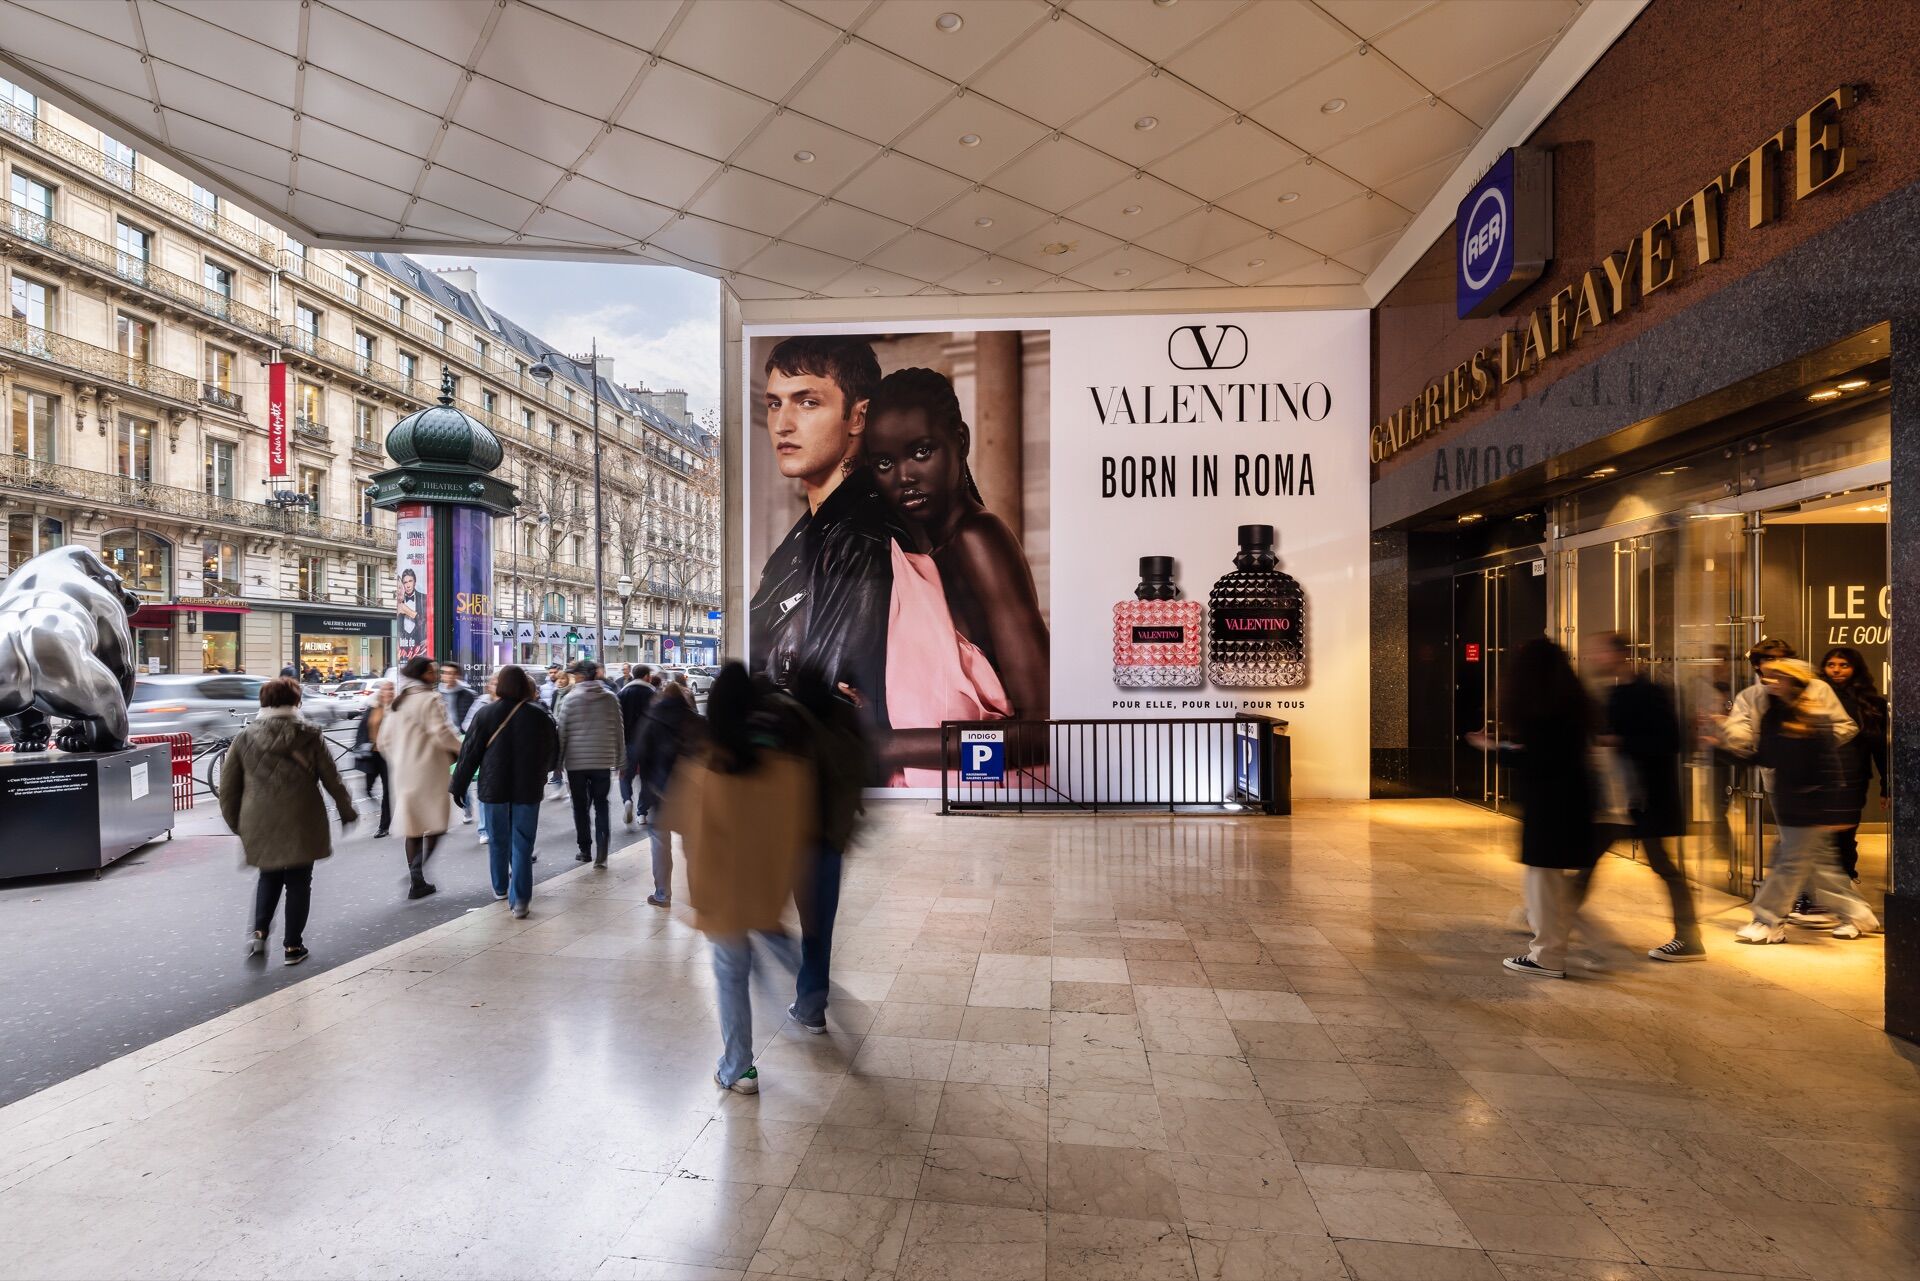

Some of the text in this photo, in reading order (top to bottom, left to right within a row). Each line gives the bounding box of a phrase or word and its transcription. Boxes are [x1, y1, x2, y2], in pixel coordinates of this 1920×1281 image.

[1467, 218, 1501, 266] RER
[1370, 86, 1850, 464] GALERIES LAFAYETTE
[1086, 381, 1332, 425] VALENTINO
[1101, 453, 1315, 498] BORN IN ROMA
[1828, 585, 1866, 619] LE
[1138, 630, 1179, 640] VALENTINO
[1225, 618, 1290, 631] VALENTINO
[1828, 626, 1849, 645] LE
[1112, 700, 1306, 710] POUR ELLE, POUR LUI, POUR TOUS
[972, 744, 993, 770] P
